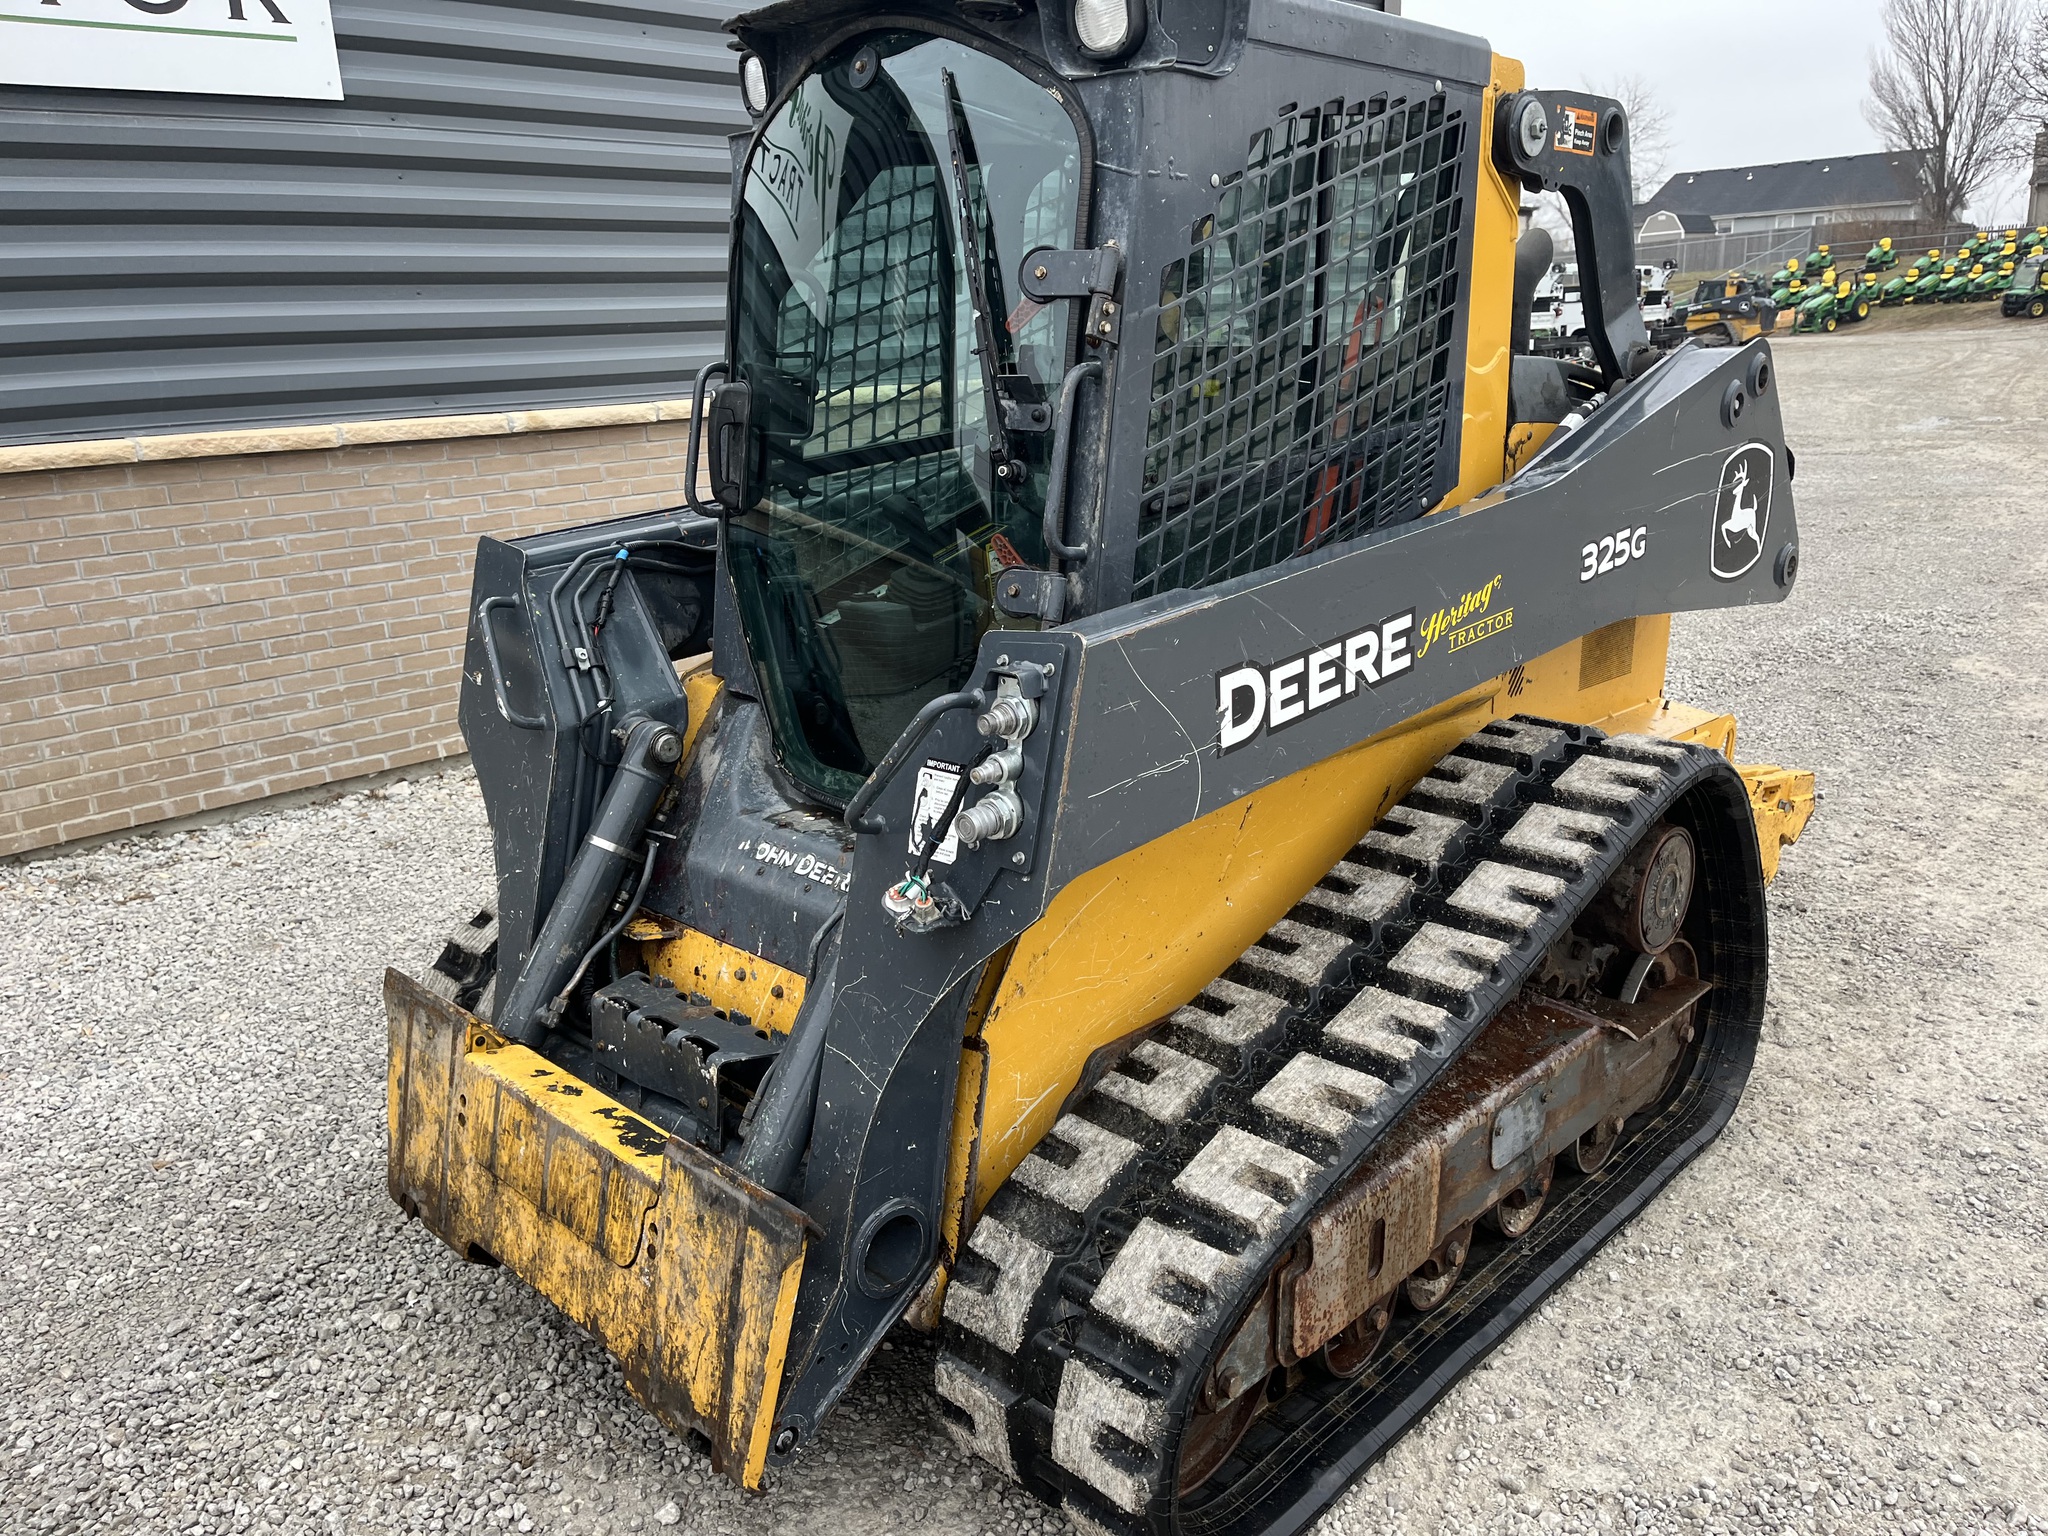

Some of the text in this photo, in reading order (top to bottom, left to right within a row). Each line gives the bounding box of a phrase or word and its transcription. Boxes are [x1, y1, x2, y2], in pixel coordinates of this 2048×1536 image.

[1580, 526, 1647, 581] 325G
[1448, 611, 1514, 649] TRACTOR
[1219, 613, 1413, 749] DEERE
[926, 759, 961, 774] IMPORTANT
[738, 840, 852, 893] OHN DEER
